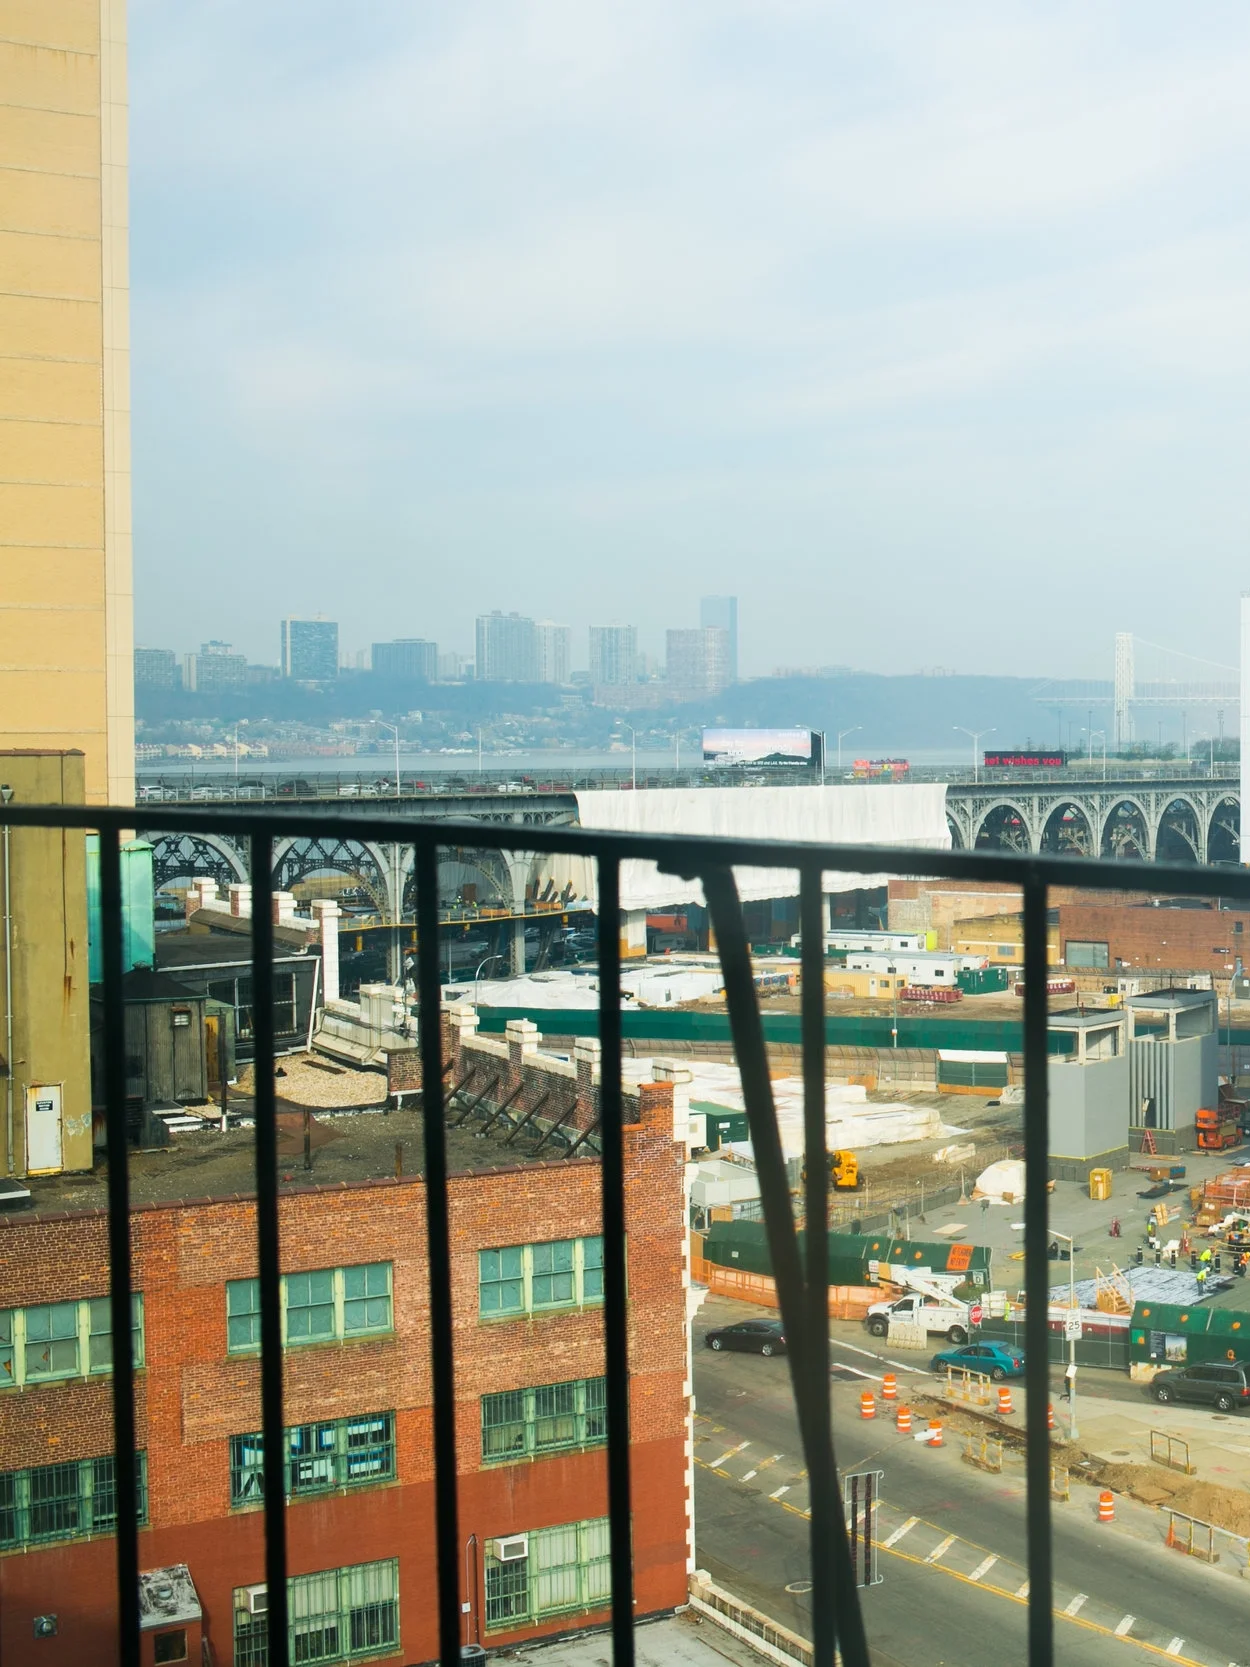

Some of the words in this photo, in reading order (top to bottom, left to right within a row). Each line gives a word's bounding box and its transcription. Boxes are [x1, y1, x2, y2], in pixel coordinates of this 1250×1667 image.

[1002, 756, 1039, 766] wishes
[1042, 757, 1062, 766] you
[1068, 1321, 1080, 1331] 25
